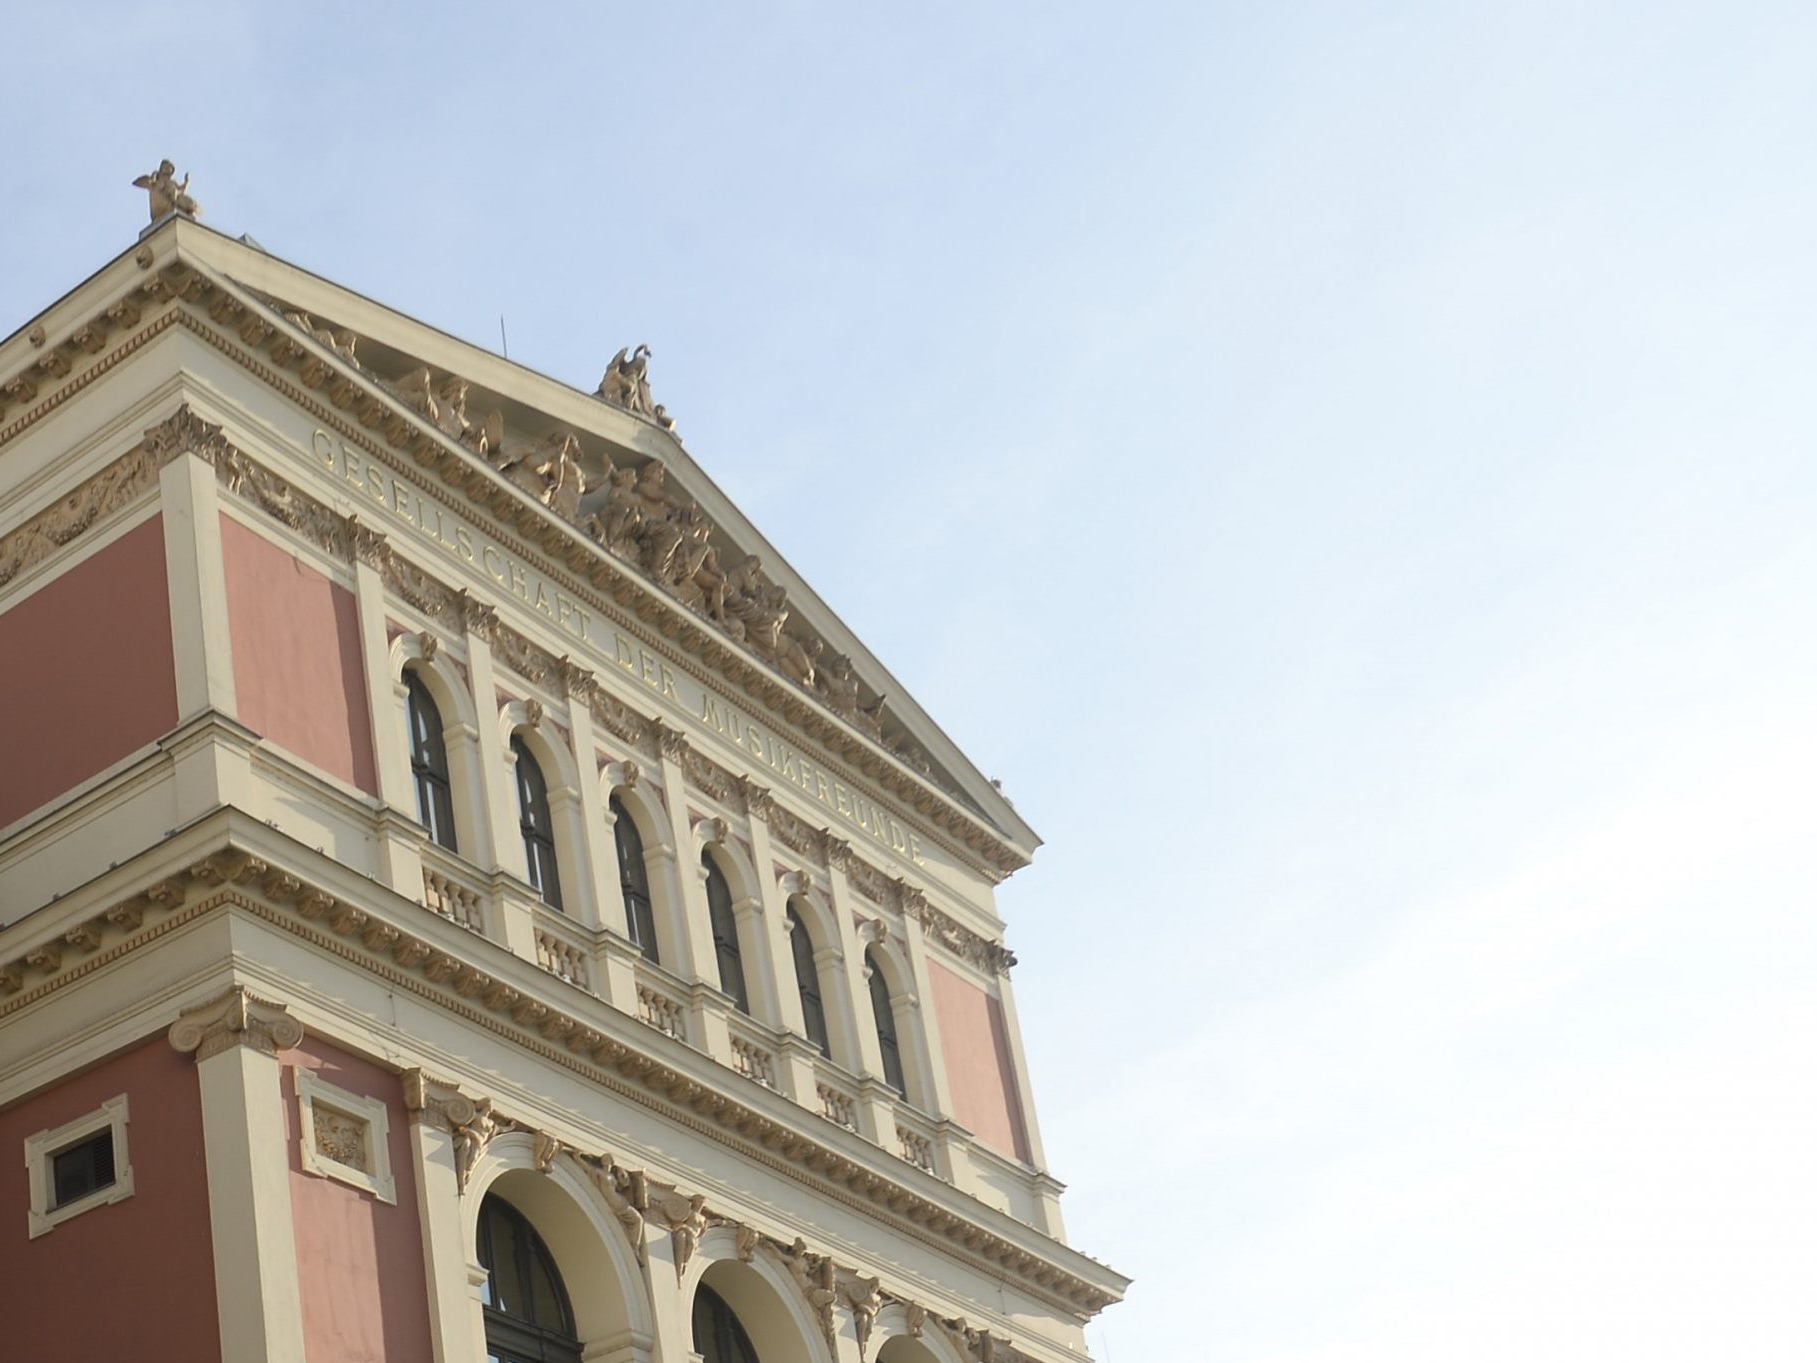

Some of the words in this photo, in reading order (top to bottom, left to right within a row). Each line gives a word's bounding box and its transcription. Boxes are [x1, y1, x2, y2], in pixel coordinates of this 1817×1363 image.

[312, 429, 591, 641] GESELLSCHAFT
[614, 633, 677, 697] DER
[701, 693, 925, 867] MUSIKFREUNDE
